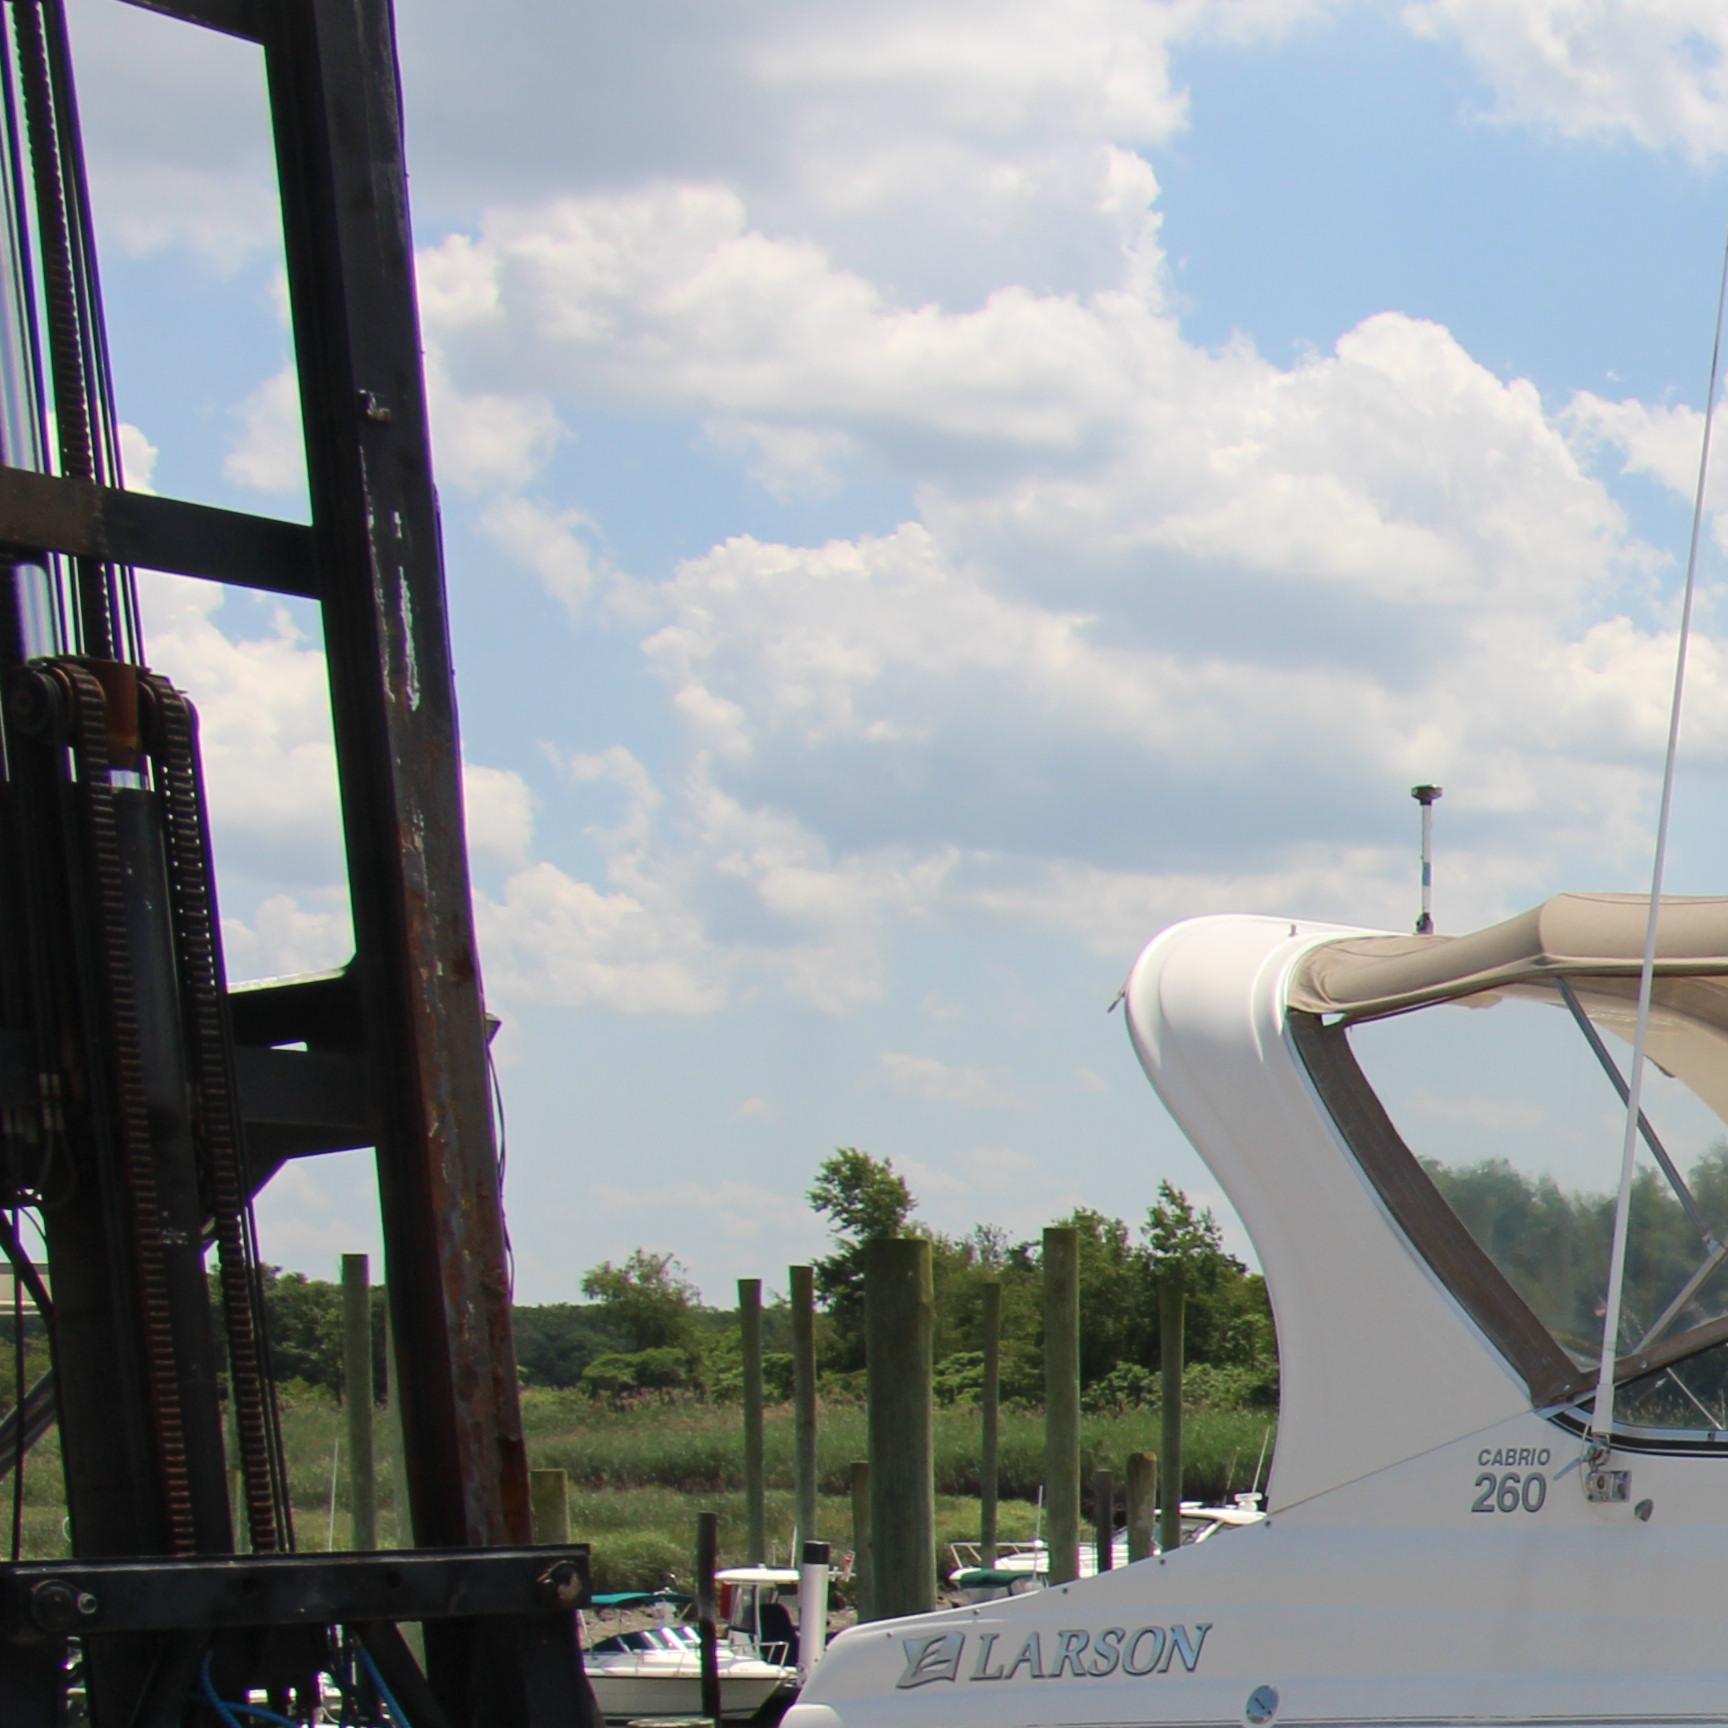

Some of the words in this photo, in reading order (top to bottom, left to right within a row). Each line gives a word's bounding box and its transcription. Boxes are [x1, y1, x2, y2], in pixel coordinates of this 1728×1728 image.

[1477, 1448, 1550, 1467] CABRIO
[1471, 1471, 1547, 1513] 260
[969, 1623, 1214, 1682] LARSON
